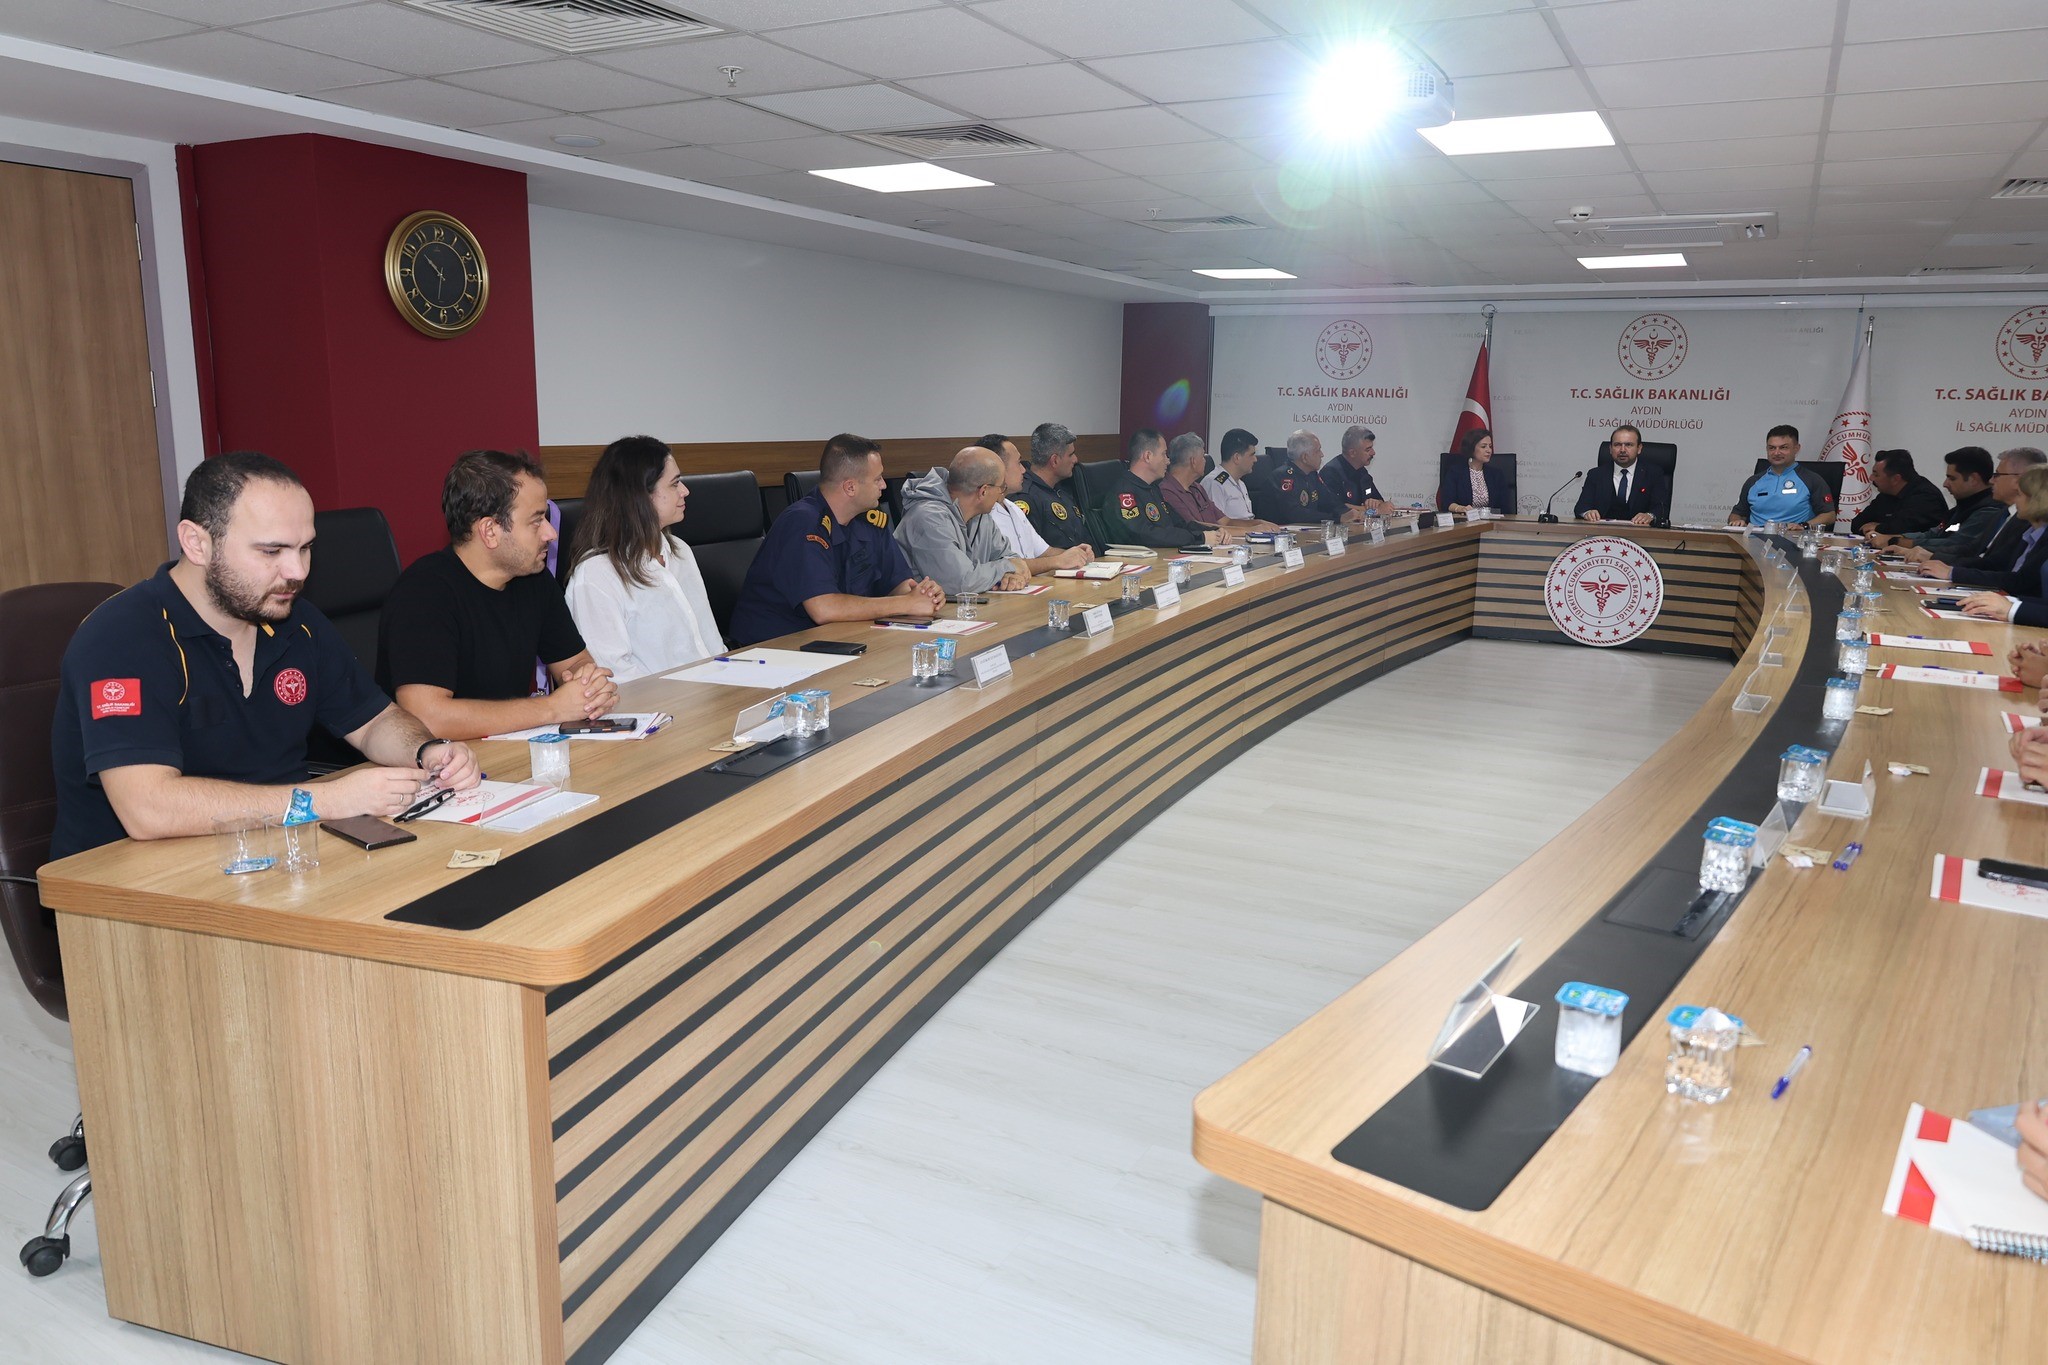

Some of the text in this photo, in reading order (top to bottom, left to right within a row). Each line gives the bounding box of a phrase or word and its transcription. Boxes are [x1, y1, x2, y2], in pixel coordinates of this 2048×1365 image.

[1277, 385, 1408, 399] T.C. SAĞLIK BAKANLIĞI
[1570, 386, 1731, 401] T.C. SAĞLIK BAKANLIĞI
[1935, 388, 1961, 400] T.C.
[1965, 386, 2027, 401] SAĞLIK
[1327, 403, 1353, 412] AYDIN
[1630, 406, 1662, 415] AYDIN
[2008, 408, 2048, 418] AYDIN
[1293, 413, 1388, 425] İL SAĞLIK MÜDÜRLÜĞÜ
[1588, 417, 1704, 430] İL SAĞLIK MÜDÜRLÜĞÜ
[1956, 420, 1966, 432] İL
[1968, 421, 2012, 433] SAĞLIK
[1566, 558, 1639, 622] TÜRKİYE CUMHURİYETİ SAĞLIK BAKANLIĞI
